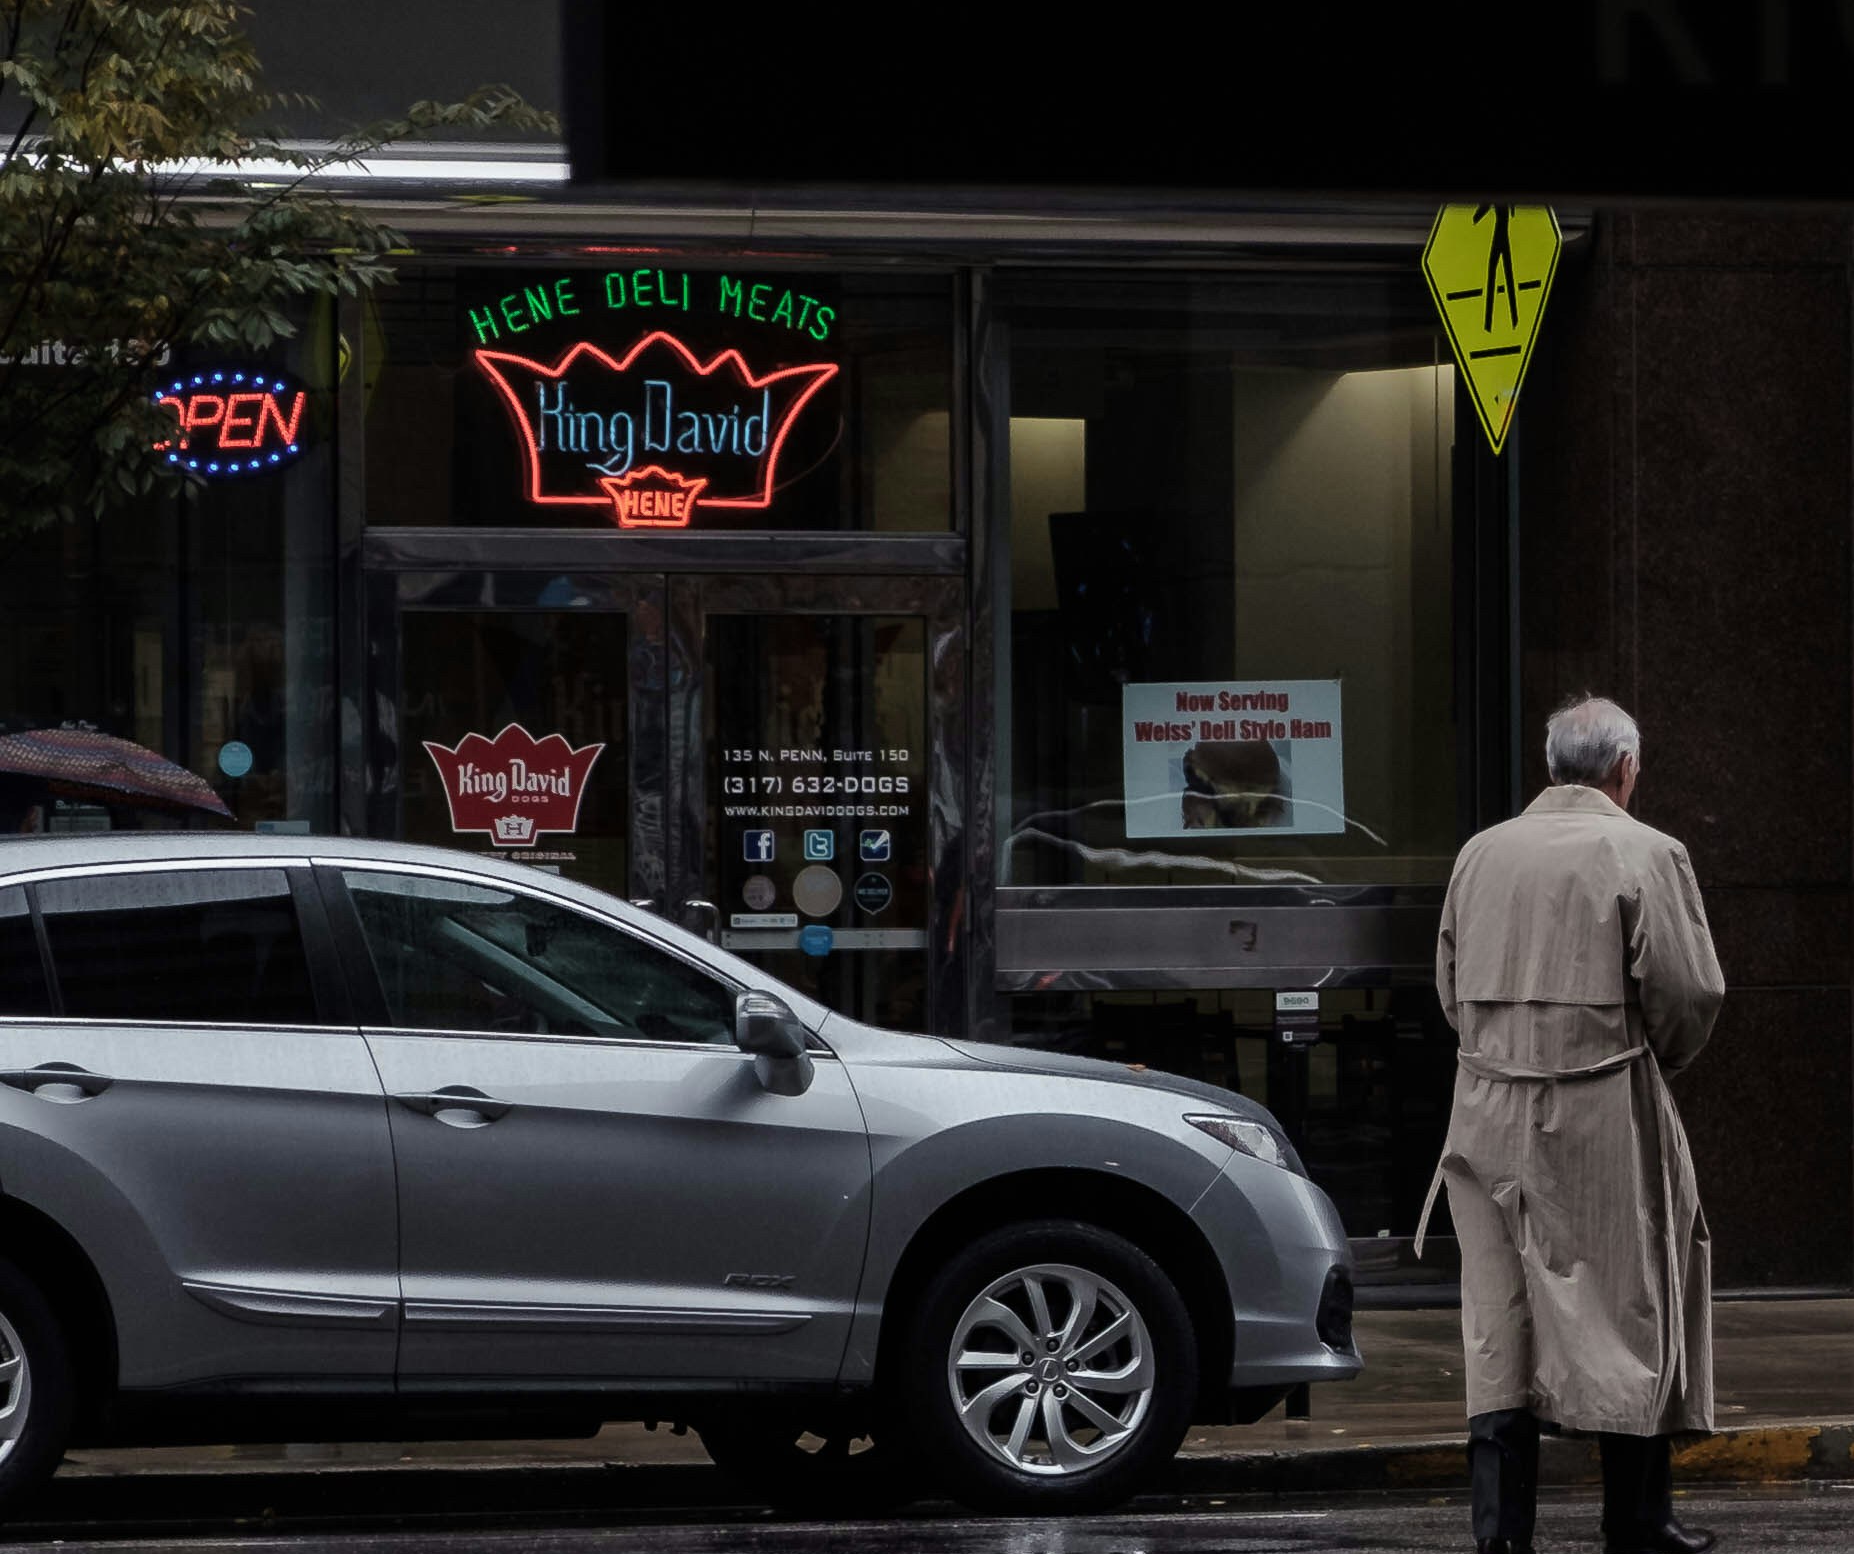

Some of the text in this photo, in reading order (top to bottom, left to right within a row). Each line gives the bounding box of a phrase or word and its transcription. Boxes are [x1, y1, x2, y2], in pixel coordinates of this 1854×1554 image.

[467, 269, 837, 344] HENE DELI MEATS
[534, 379, 771, 477] King David
[622, 490, 684, 517] HENE
[1176, 690, 1289, 712] Now Serving
[1135, 718, 1331, 742] Weiss' Deli Style Ham
[724, 749, 752, 762] 135
[759, 749, 774, 762] N.
[780, 749, 828, 763] PENN,
[880, 749, 909, 762] 150
[457, 759, 571, 803] King David
[724, 776, 783, 794] (317)
[511, 795, 549, 803] DOGS
